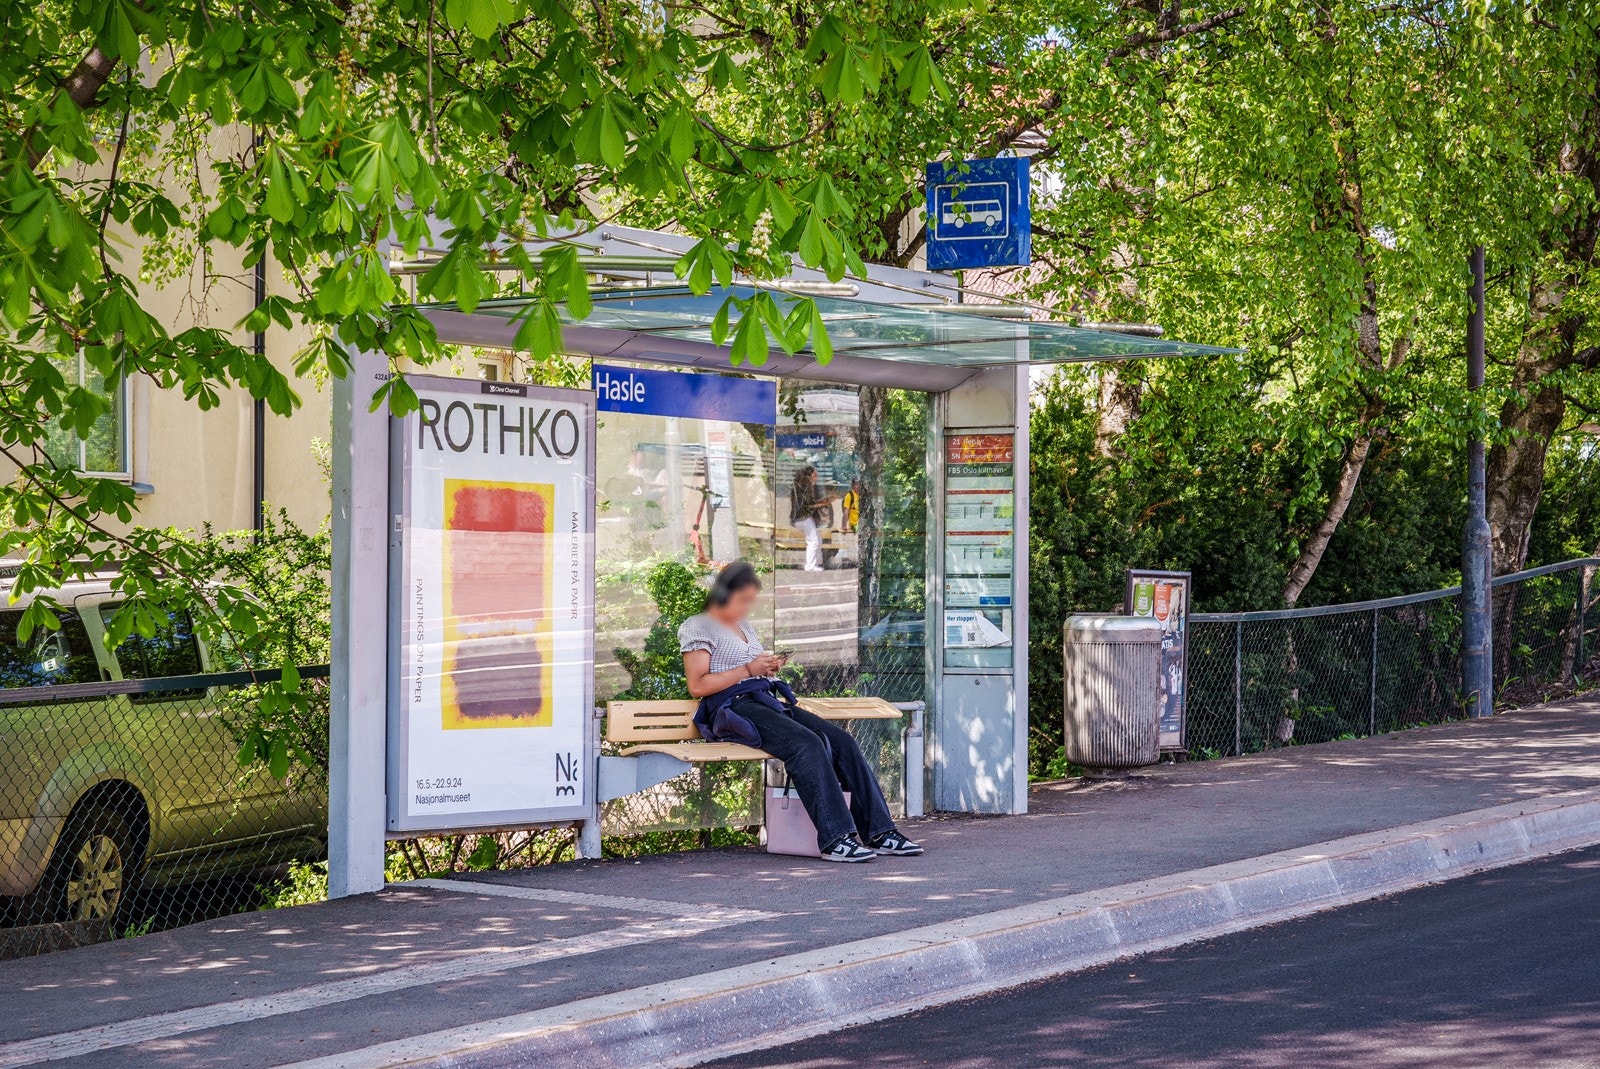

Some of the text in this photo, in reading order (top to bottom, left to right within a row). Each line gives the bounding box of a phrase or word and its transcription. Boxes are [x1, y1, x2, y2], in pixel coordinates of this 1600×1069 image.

[596, 372, 645, 402] Hasle
[418, 398, 580, 460] ROTHKO
[962, 466, 977, 474] Oslo
[571, 511, 579, 567] MALERIER
[571, 570, 580, 585] PÅ
[414, 578, 424, 703] PAINTINGS ON PAPER
[1161, 639, 1173, 650] ATIS
[415, 793, 471, 806] Nasjonalmuseet
